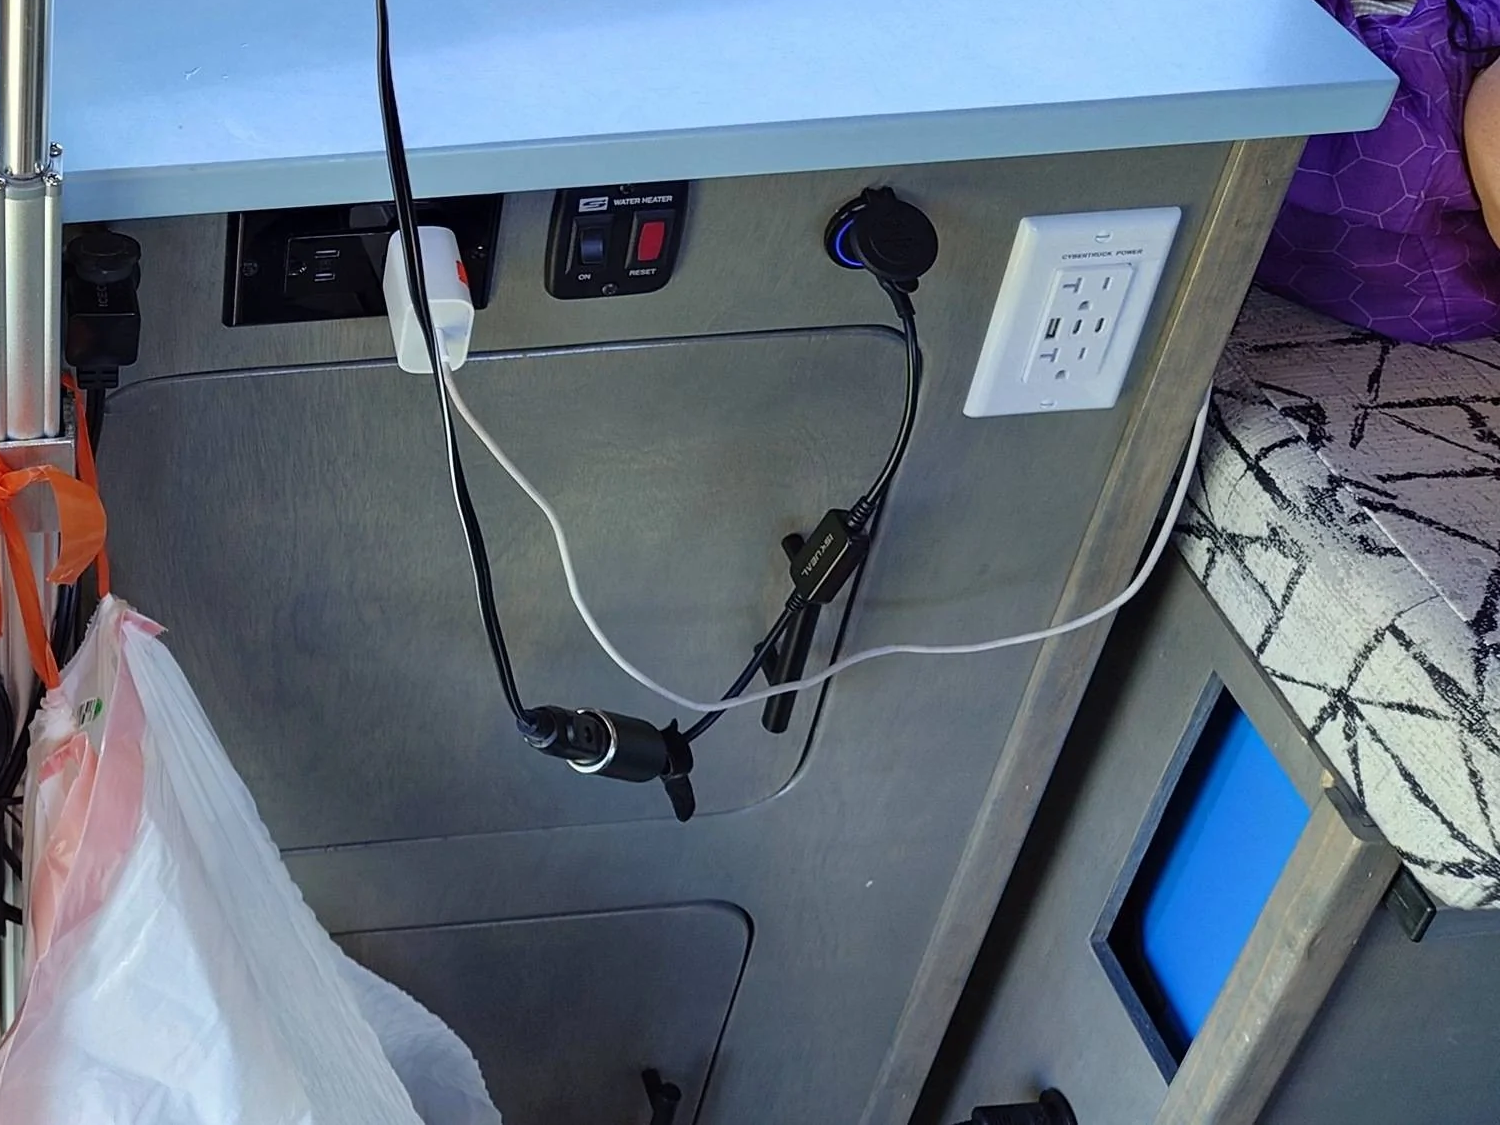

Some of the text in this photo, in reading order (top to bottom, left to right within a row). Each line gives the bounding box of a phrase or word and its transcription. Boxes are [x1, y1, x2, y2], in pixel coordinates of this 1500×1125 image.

[613, 195, 673, 206] WATER HEATER
[1061, 248, 1143, 260] CYBERTRUCK POWER
[628, 268, 657, 276] RESET
